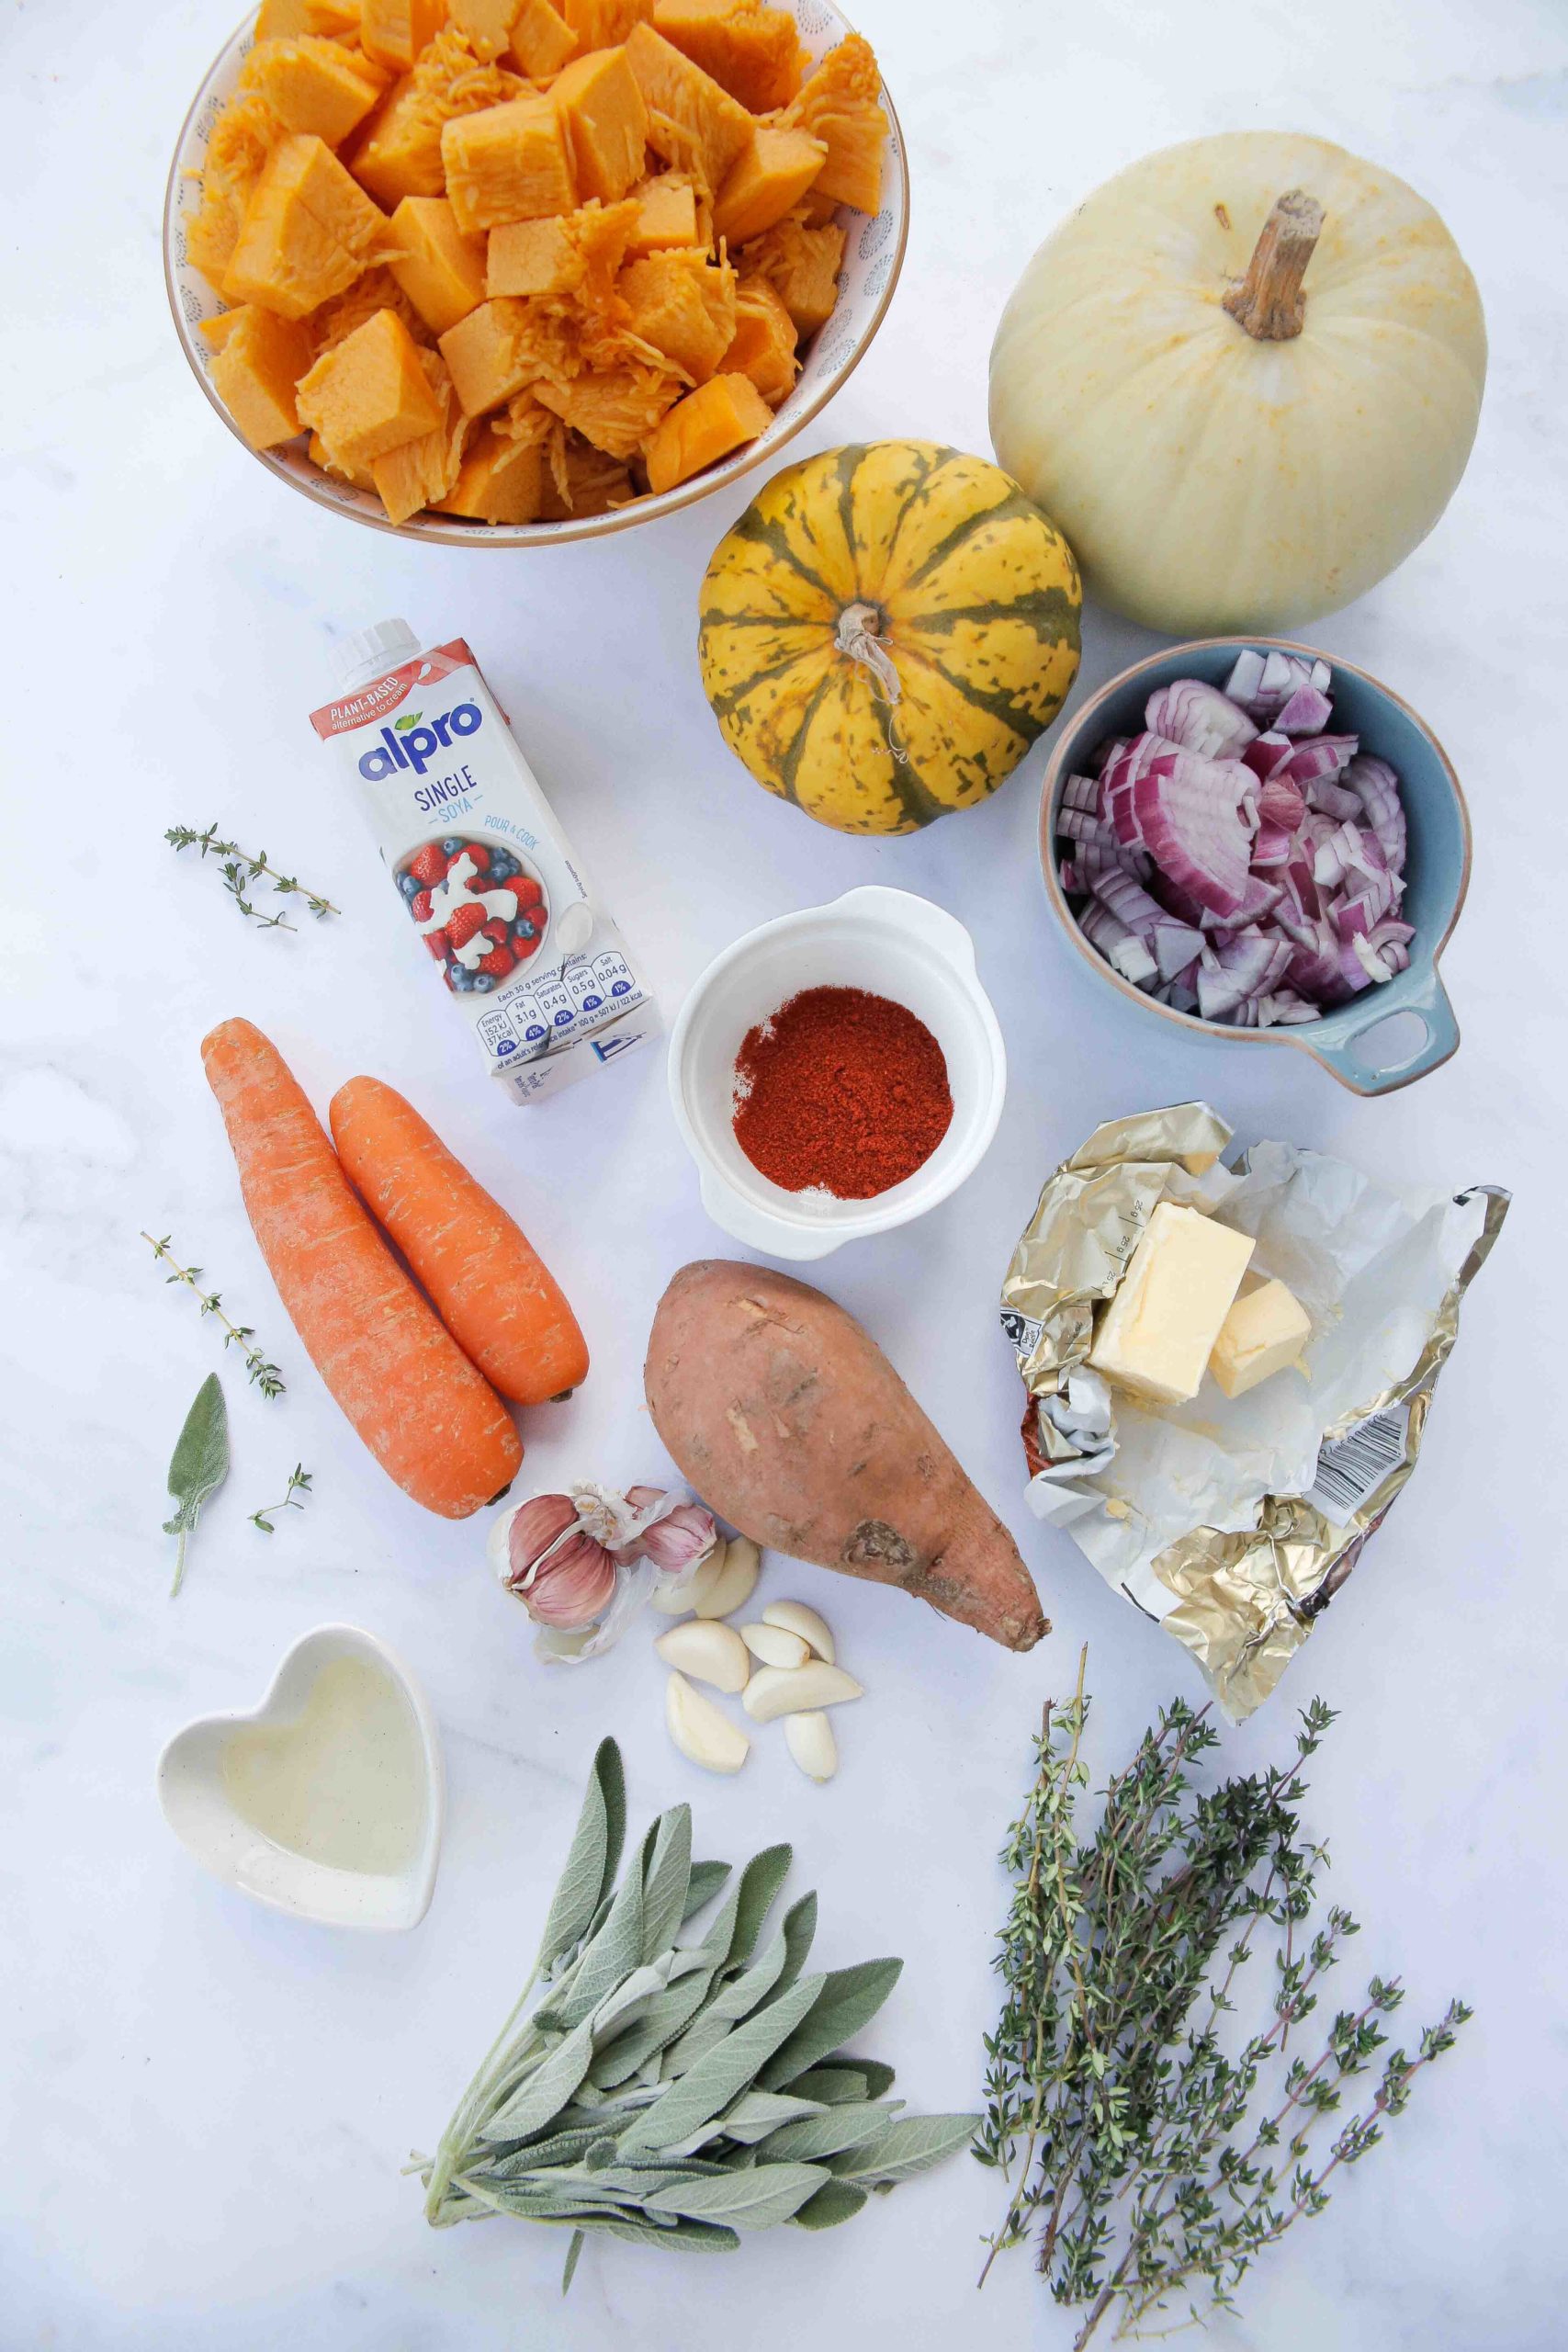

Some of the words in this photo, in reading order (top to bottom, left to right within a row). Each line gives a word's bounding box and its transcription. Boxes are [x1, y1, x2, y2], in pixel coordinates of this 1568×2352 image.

[331, 676, 398, 721] PLANT-BASED
[332, 709, 377, 730] alternative
[376, 704, 386, 713] to
[386, 683, 408, 706] cream
[358, 703, 482, 781] alpro
[414, 764, 477, 811] SINGLE
[438, 797, 473, 823] SOYA
[484, 815, 510, 832] POUR
[510, 825, 515, 834] &
[515, 828, 540, 850] COOK
[600, 956, 613, 966] Salt
[567, 969, 588, 983] Sugars
[598, 966, 618, 981] 0.04
[497, 989, 514, 1002] Each
[514, 984, 524, 993] 30
[525, 982, 531, 990] g
[531, 969, 557, 985] serving
[536, 983, 562, 999] Saturates
[571, 981, 587, 995] 0.5
[614, 982, 626, 993] 1%
[514, 1001, 525, 1010] Fat
[543, 997, 558, 1010] 0.4
[586, 997, 598, 1008] 1%
[480, 1013, 502, 1028] Energy
[557, 1012, 570, 1023] 2%
[485, 1024, 499, 1037] 152
[498, 1021, 507, 1030] kJ
[497, 1061, 504, 1069] of
[513, 1048, 531, 1061] adult's
[578, 1017, 589, 1027] 100
[589, 1015, 595, 1023] g
[598, 1006, 609, 1017] 507
[609, 1002, 616, 1011] kJ
[621, 997, 631, 1005] 122
[630, 990, 643, 1001] kcal
[528, 1026, 541, 1037] 4%
[487, 1035, 497, 1046] 37
[498, 1027, 513, 1040] kcal
[499, 1042, 513, 1053] 2%
[1134, 1199, 1143, 1212] 25
[1121, 1236, 1130, 1248] 25
[1106, 1271, 1116, 1282] 25
